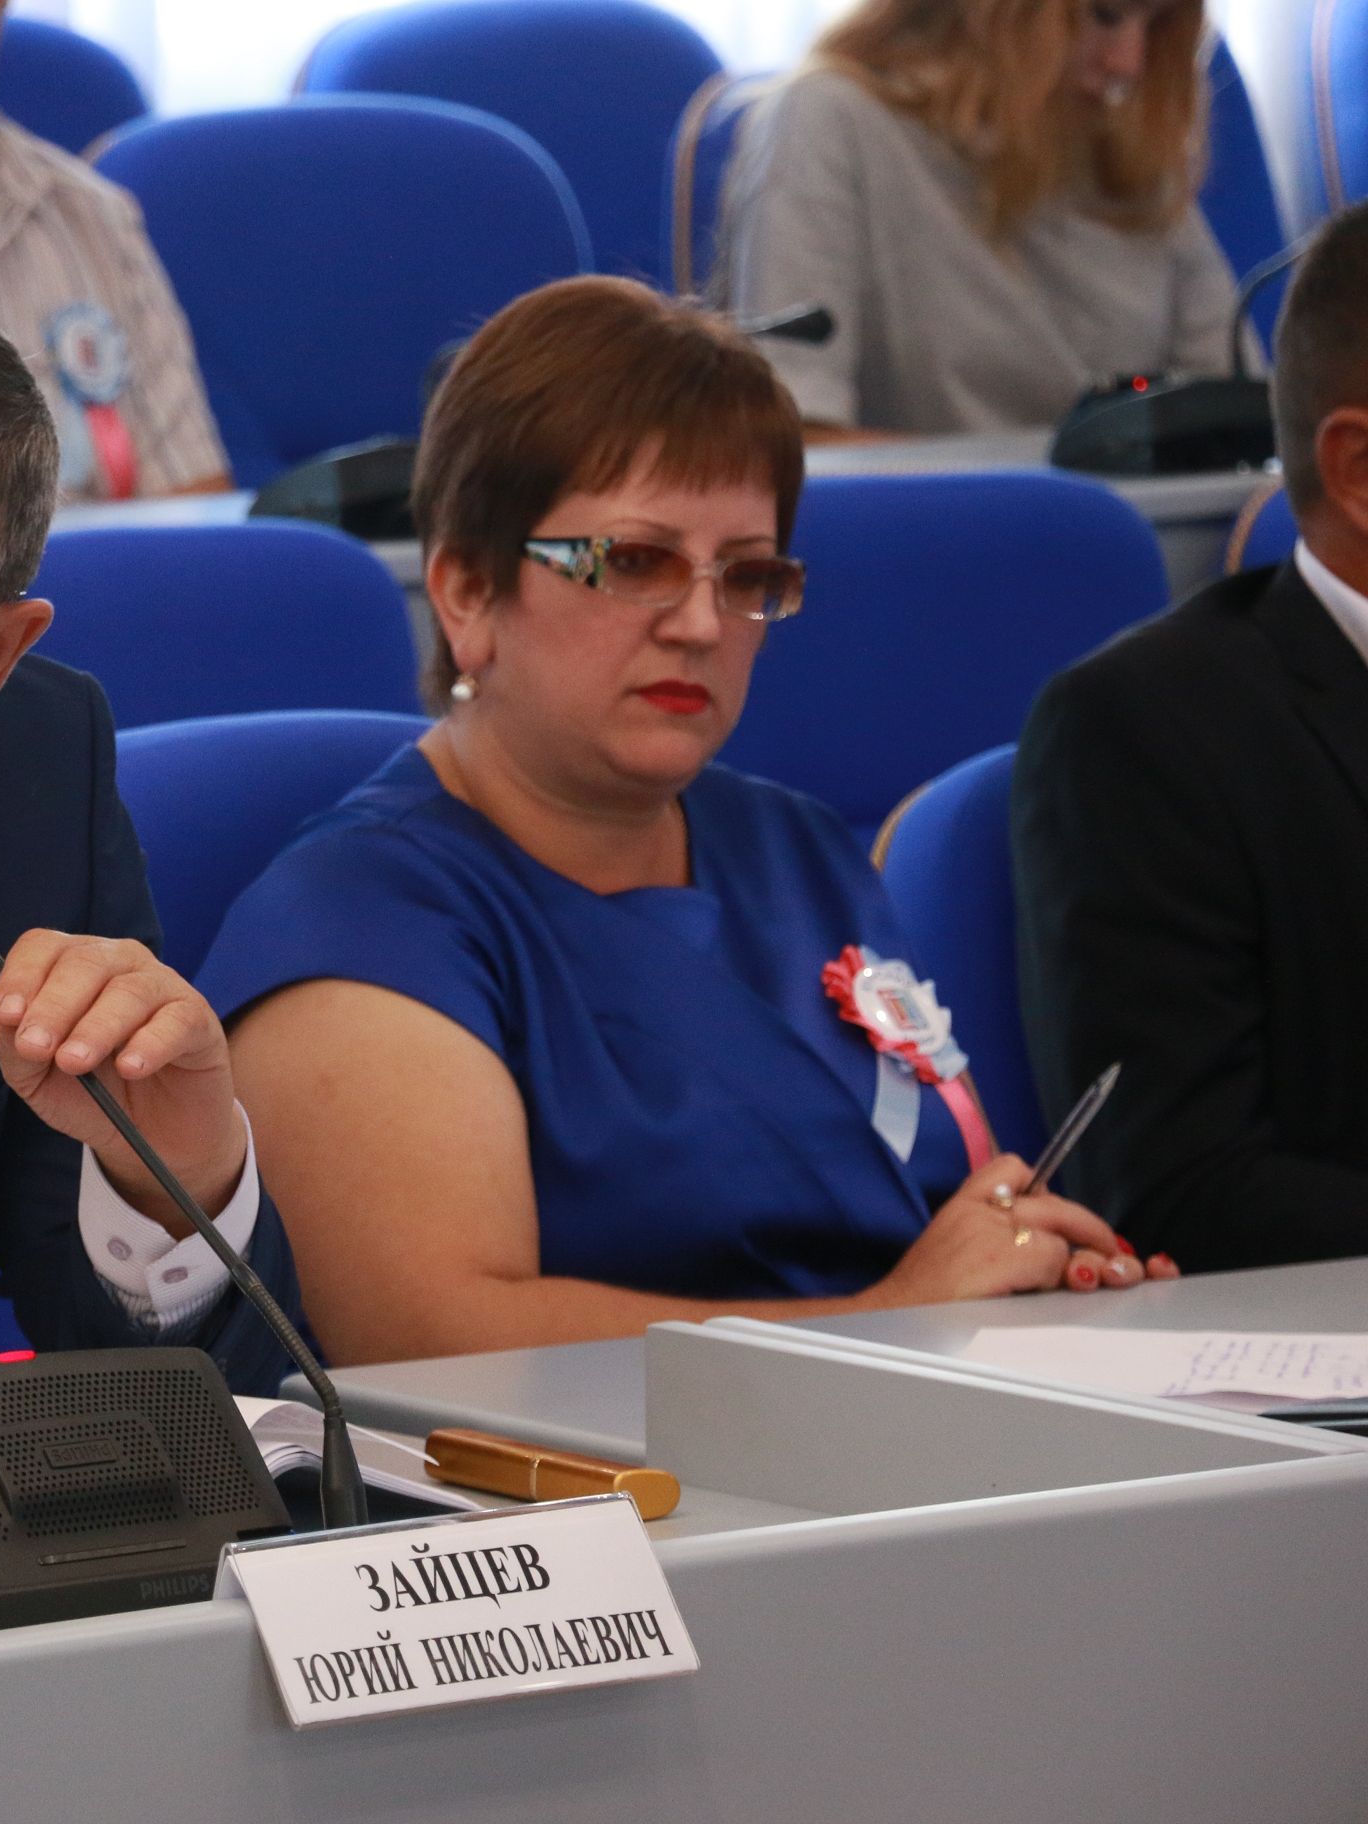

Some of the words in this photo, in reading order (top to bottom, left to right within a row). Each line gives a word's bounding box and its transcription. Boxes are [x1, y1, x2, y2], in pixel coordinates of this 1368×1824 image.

[51, 1443, 111, 1461] PHILIPS
[140, 1574, 211, 1600] PHILIPS
[354, 1542, 551, 1612] ЗАЙЦЕВ
[293, 1630, 418, 1704] ЮРИЙ
[419, 1609, 674, 1686] НИКОЛАЕВИЧ
